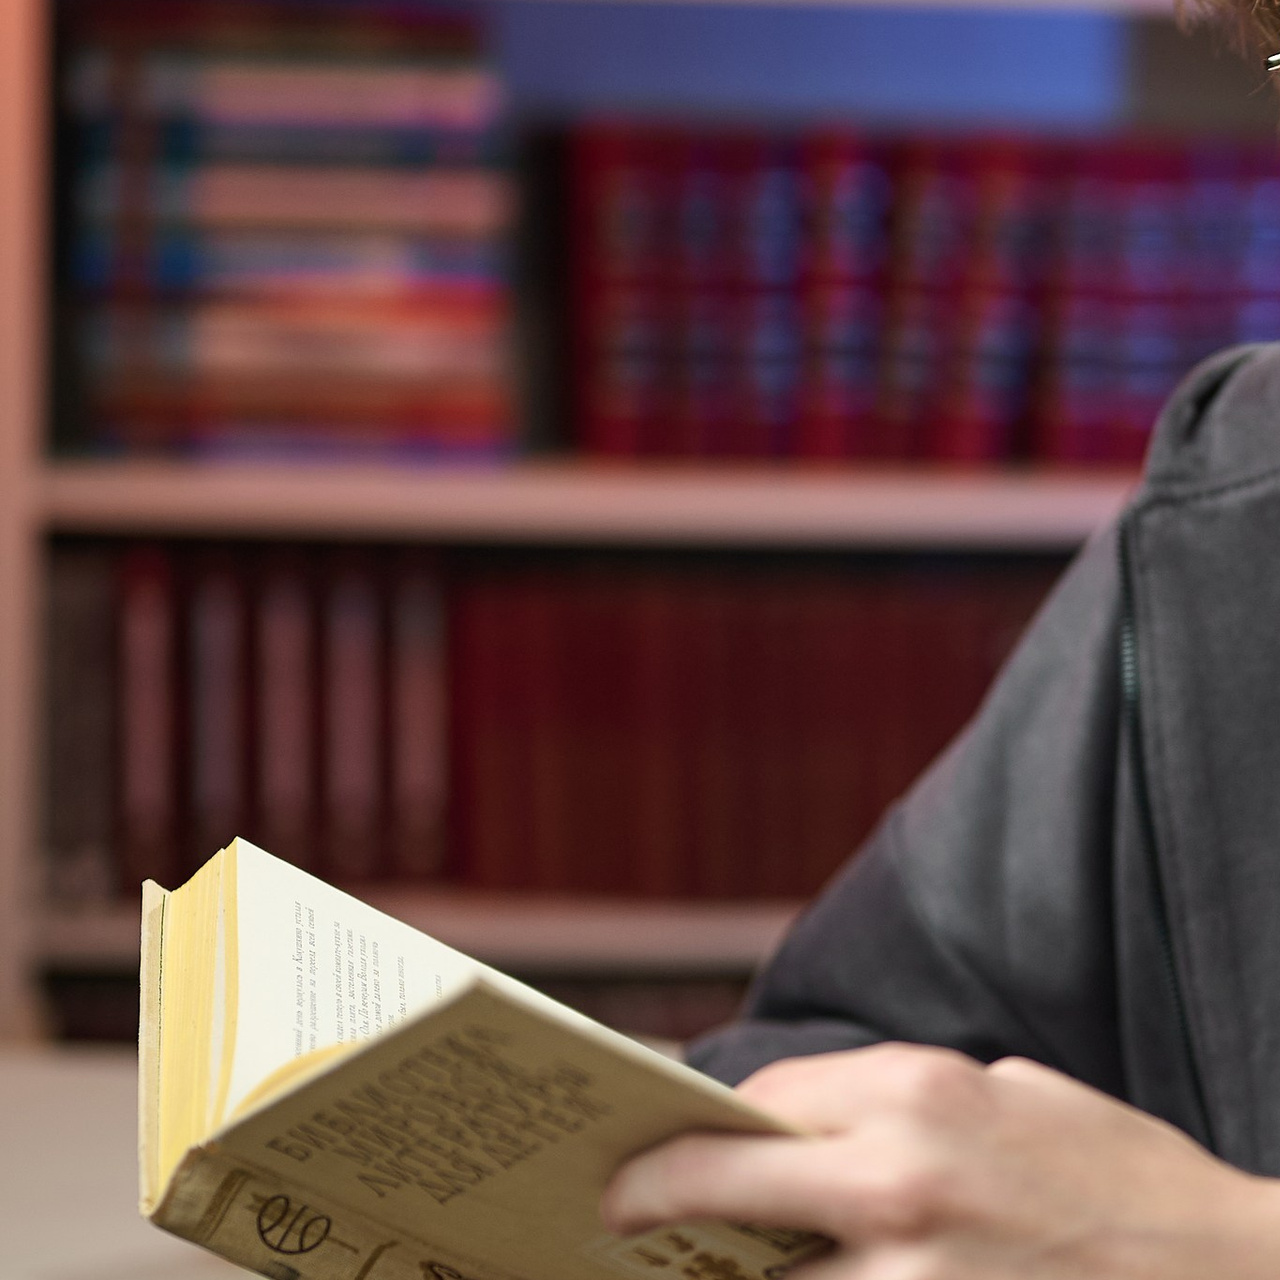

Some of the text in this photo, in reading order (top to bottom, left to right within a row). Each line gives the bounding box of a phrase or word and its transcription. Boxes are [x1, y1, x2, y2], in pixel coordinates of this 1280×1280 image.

[264, 1024, 511, 1162] БИБЛИОТЕКА
[331, 1058, 526, 1165] МИРОВОЙ
[356, 1060, 593, 1199] ЛИТЕРАТУРЫ
